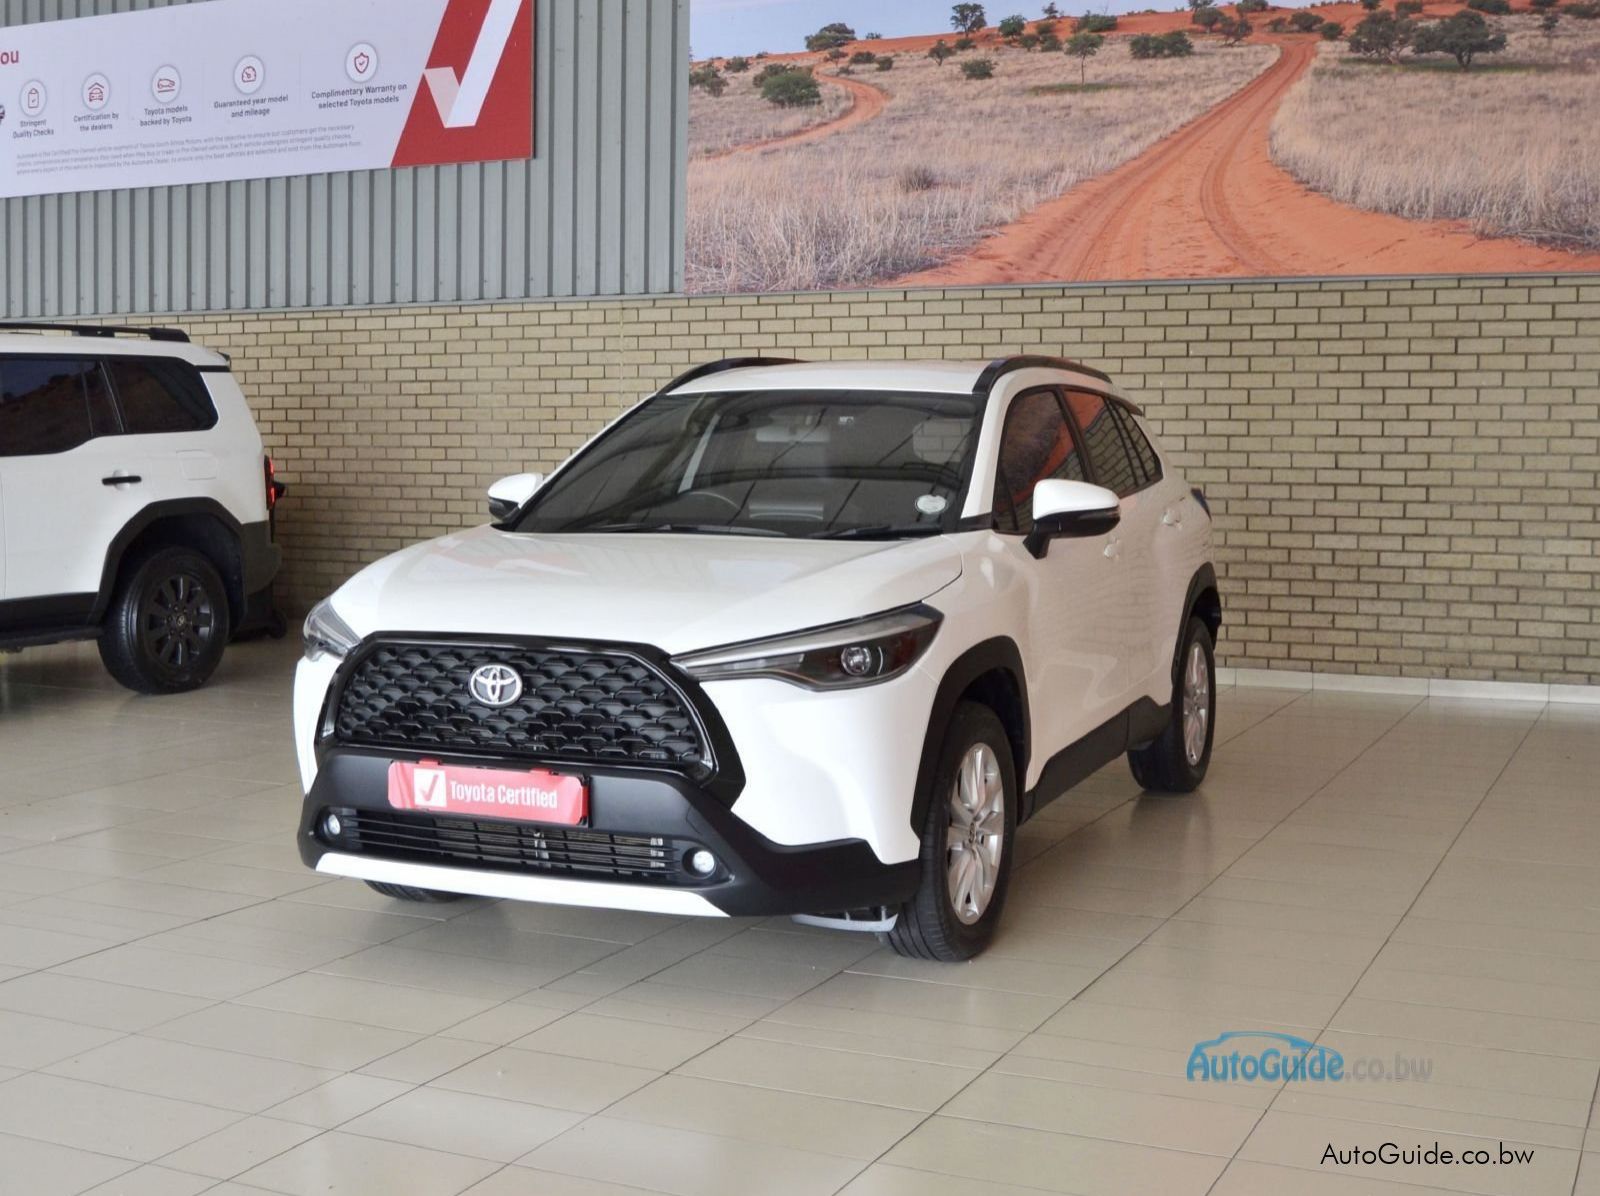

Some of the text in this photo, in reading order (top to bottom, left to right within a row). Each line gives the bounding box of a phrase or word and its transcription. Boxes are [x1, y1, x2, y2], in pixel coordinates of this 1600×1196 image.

[0, 50, 19, 65] ou
[312, 88, 363, 99] Complimentary
[365, 85, 396, 93] Warranty
[214, 94, 289, 109] Guaranteed year model
[319, 96, 399, 109] selected Toyota models
[144, 105, 188, 116] Toyota models
[231, 108, 270, 118] and mileage
[73, 112, 119, 122] Certification by
[140, 115, 192, 127] backed by Toyota
[20, 119, 47, 128] Stringent
[91, 123, 113, 131] dealers
[12, 128, 54, 139] Quality Checks
[450, 781, 558, 809] Toyota Certified
